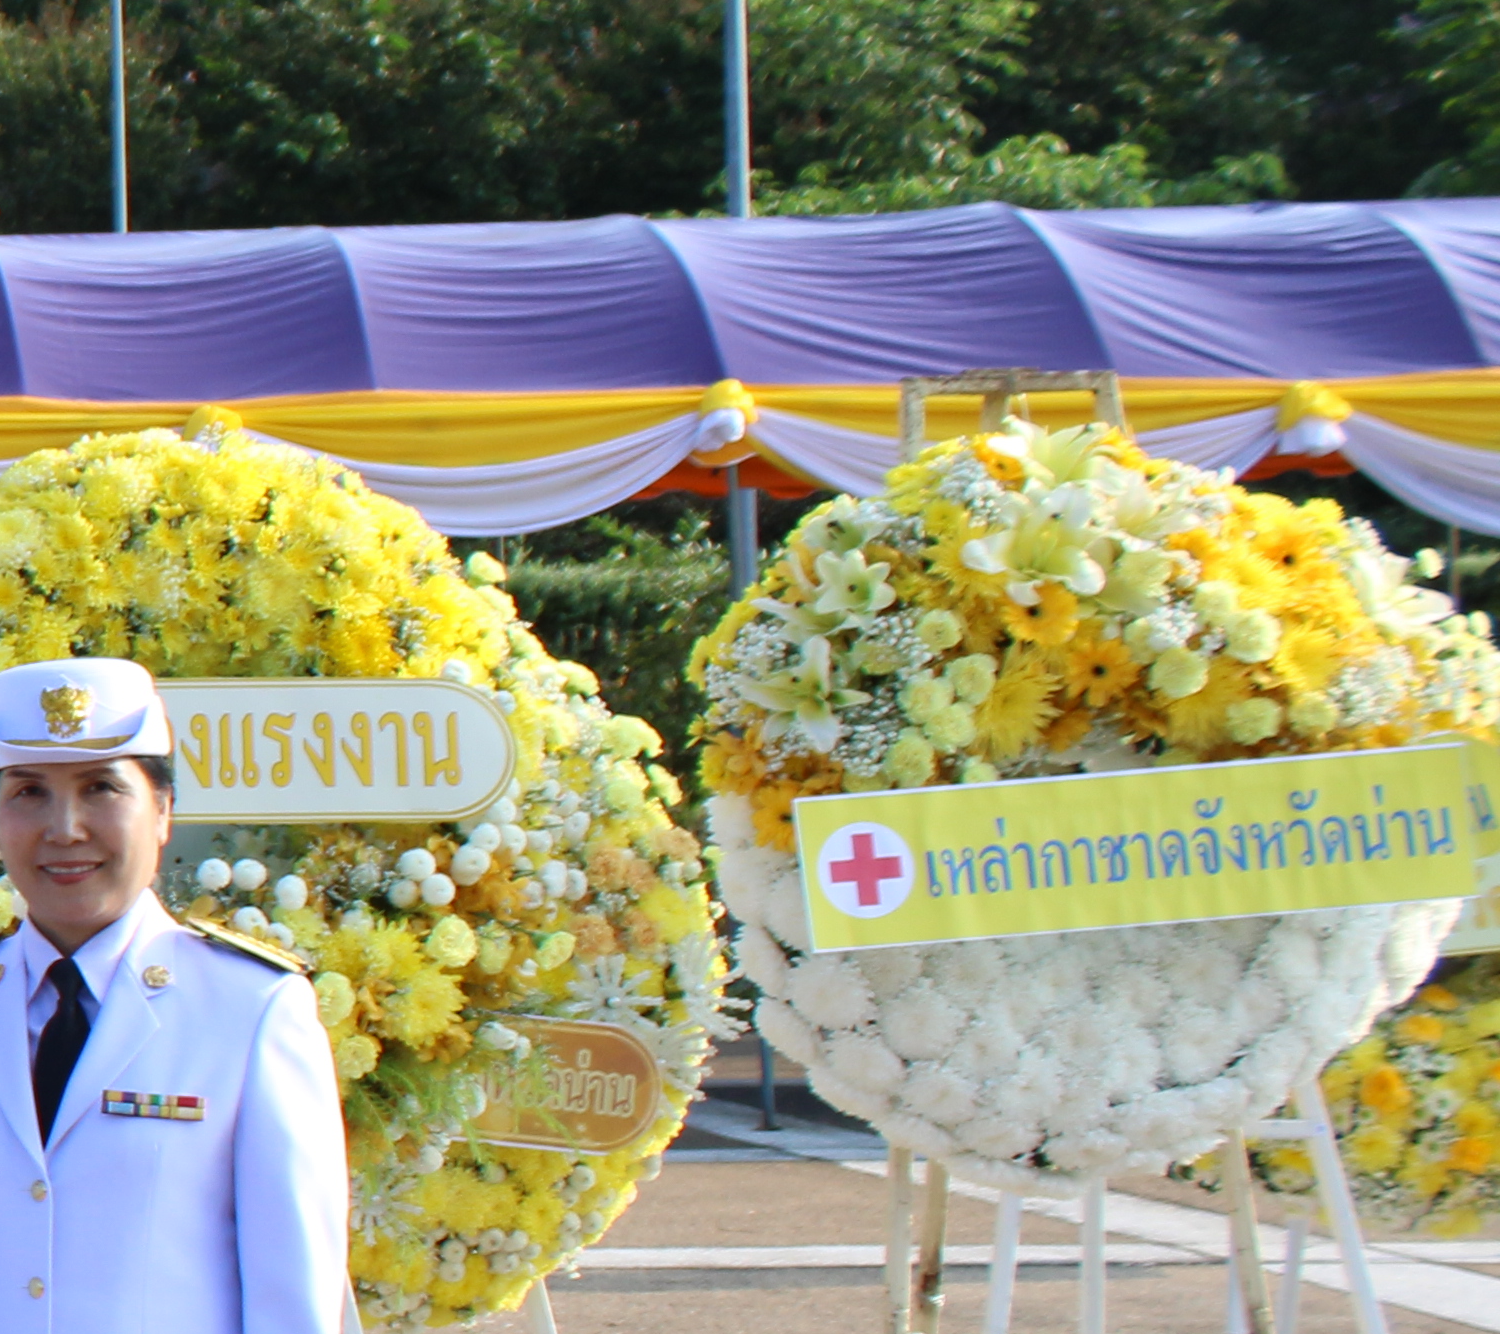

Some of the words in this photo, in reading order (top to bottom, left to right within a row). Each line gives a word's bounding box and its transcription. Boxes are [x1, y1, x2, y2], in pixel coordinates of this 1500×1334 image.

[924, 784, 1456, 898] เหล่ากาชาดจังหวัดน่าน
